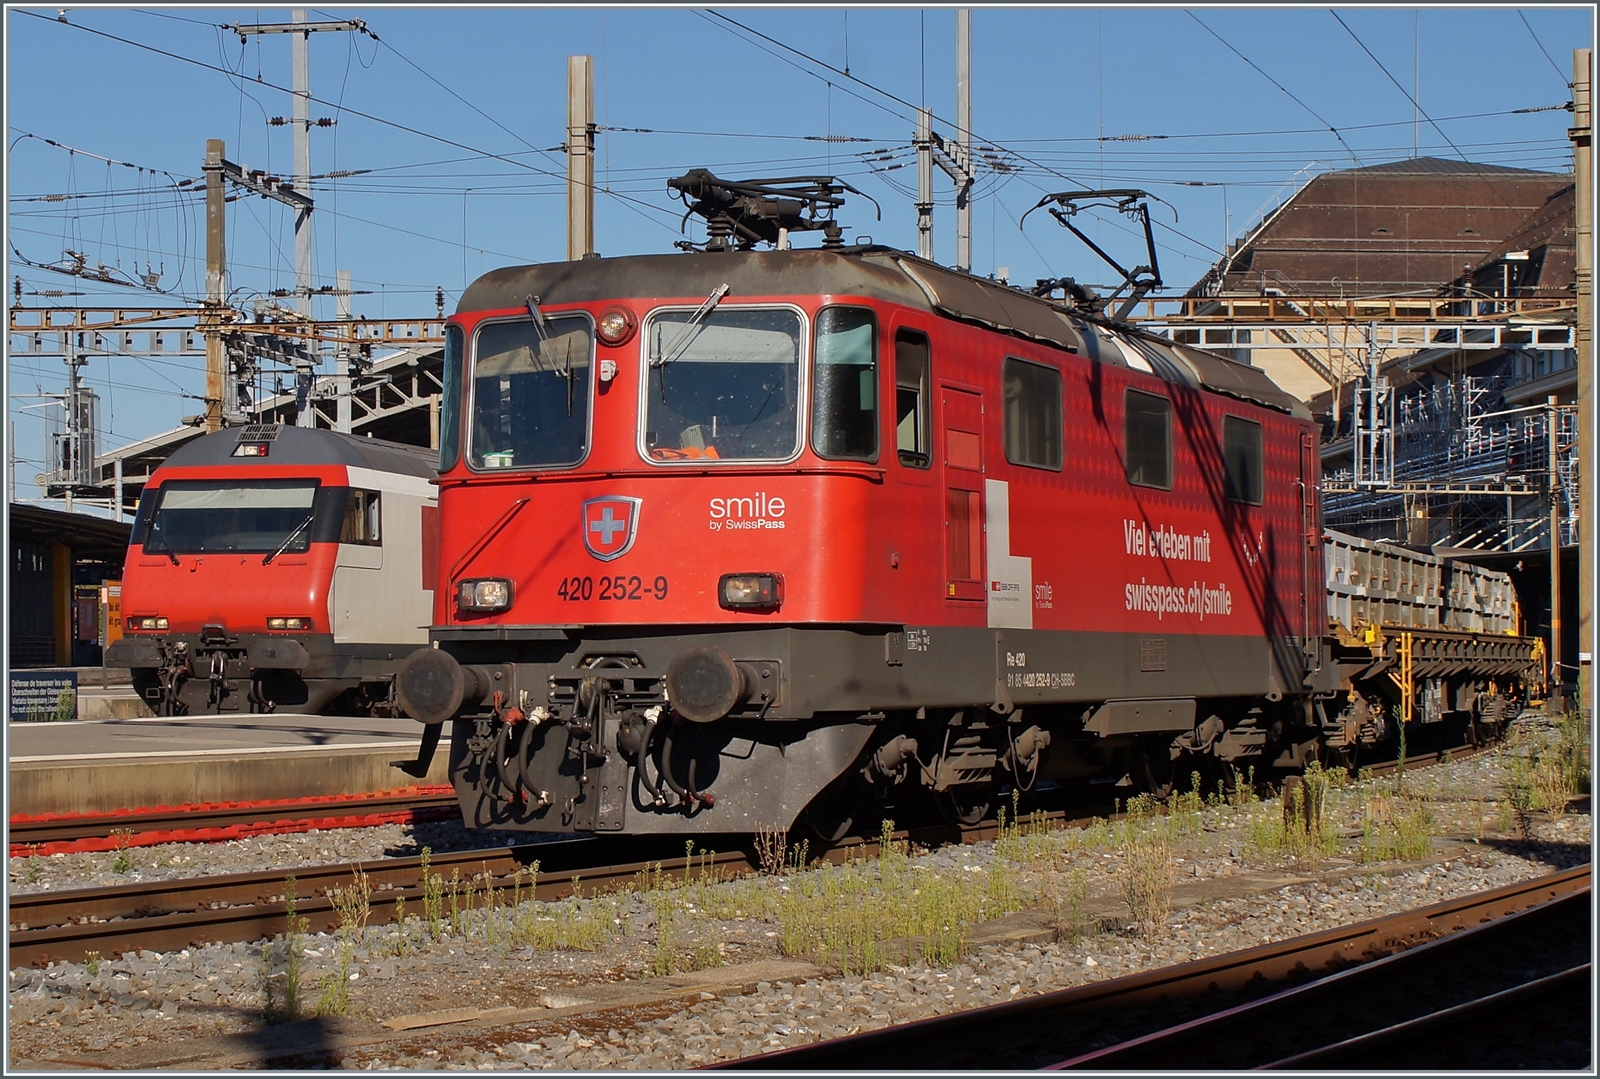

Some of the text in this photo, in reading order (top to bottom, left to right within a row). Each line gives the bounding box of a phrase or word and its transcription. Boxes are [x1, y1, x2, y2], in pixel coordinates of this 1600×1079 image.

[709, 491, 786, 518] smile
[709, 519, 786, 532] by SwissPass
[1123, 518, 1211, 563] Viel erleben mit
[557, 575, 669, 602] 420 252-9
[1035, 581, 1053, 600] smile
[1125, 576, 1232, 622] swisspass.ch/smile
[1006, 652, 1026, 667] Re 420
[29, 679, 36, 687] de
[1007, 673, 1014, 687] 91
[1035, 672, 1051, 687] 252-9
